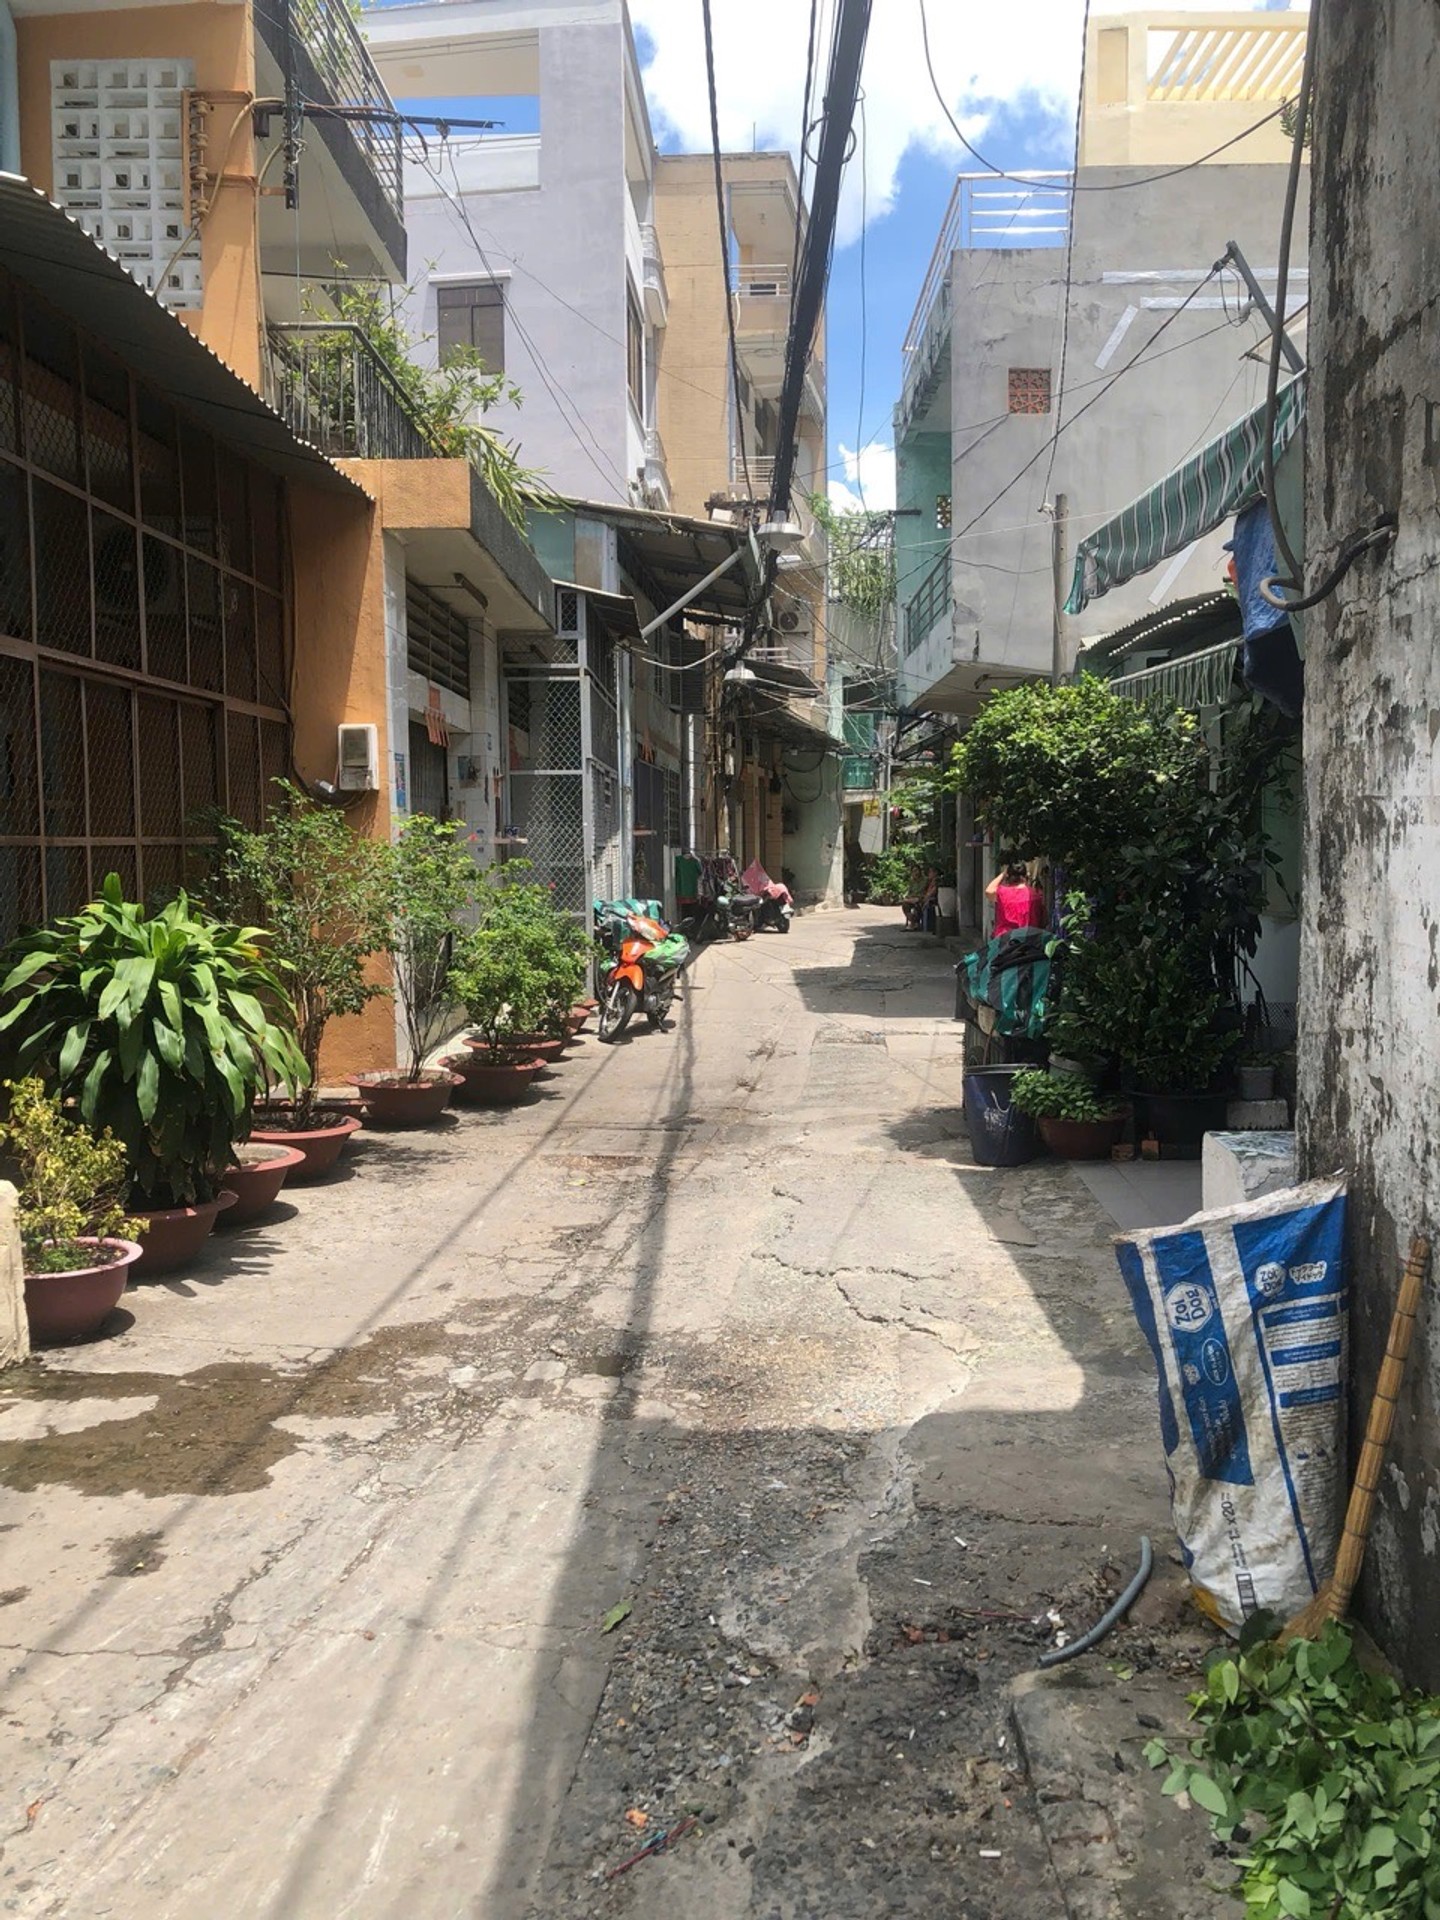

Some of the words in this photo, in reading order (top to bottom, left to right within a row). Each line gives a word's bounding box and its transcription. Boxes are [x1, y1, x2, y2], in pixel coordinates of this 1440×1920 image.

[1171, 1298, 1191, 1325] Zoi
[1185, 1288, 1207, 1320] Dog
[1221, 1501, 1235, 1518] 20
